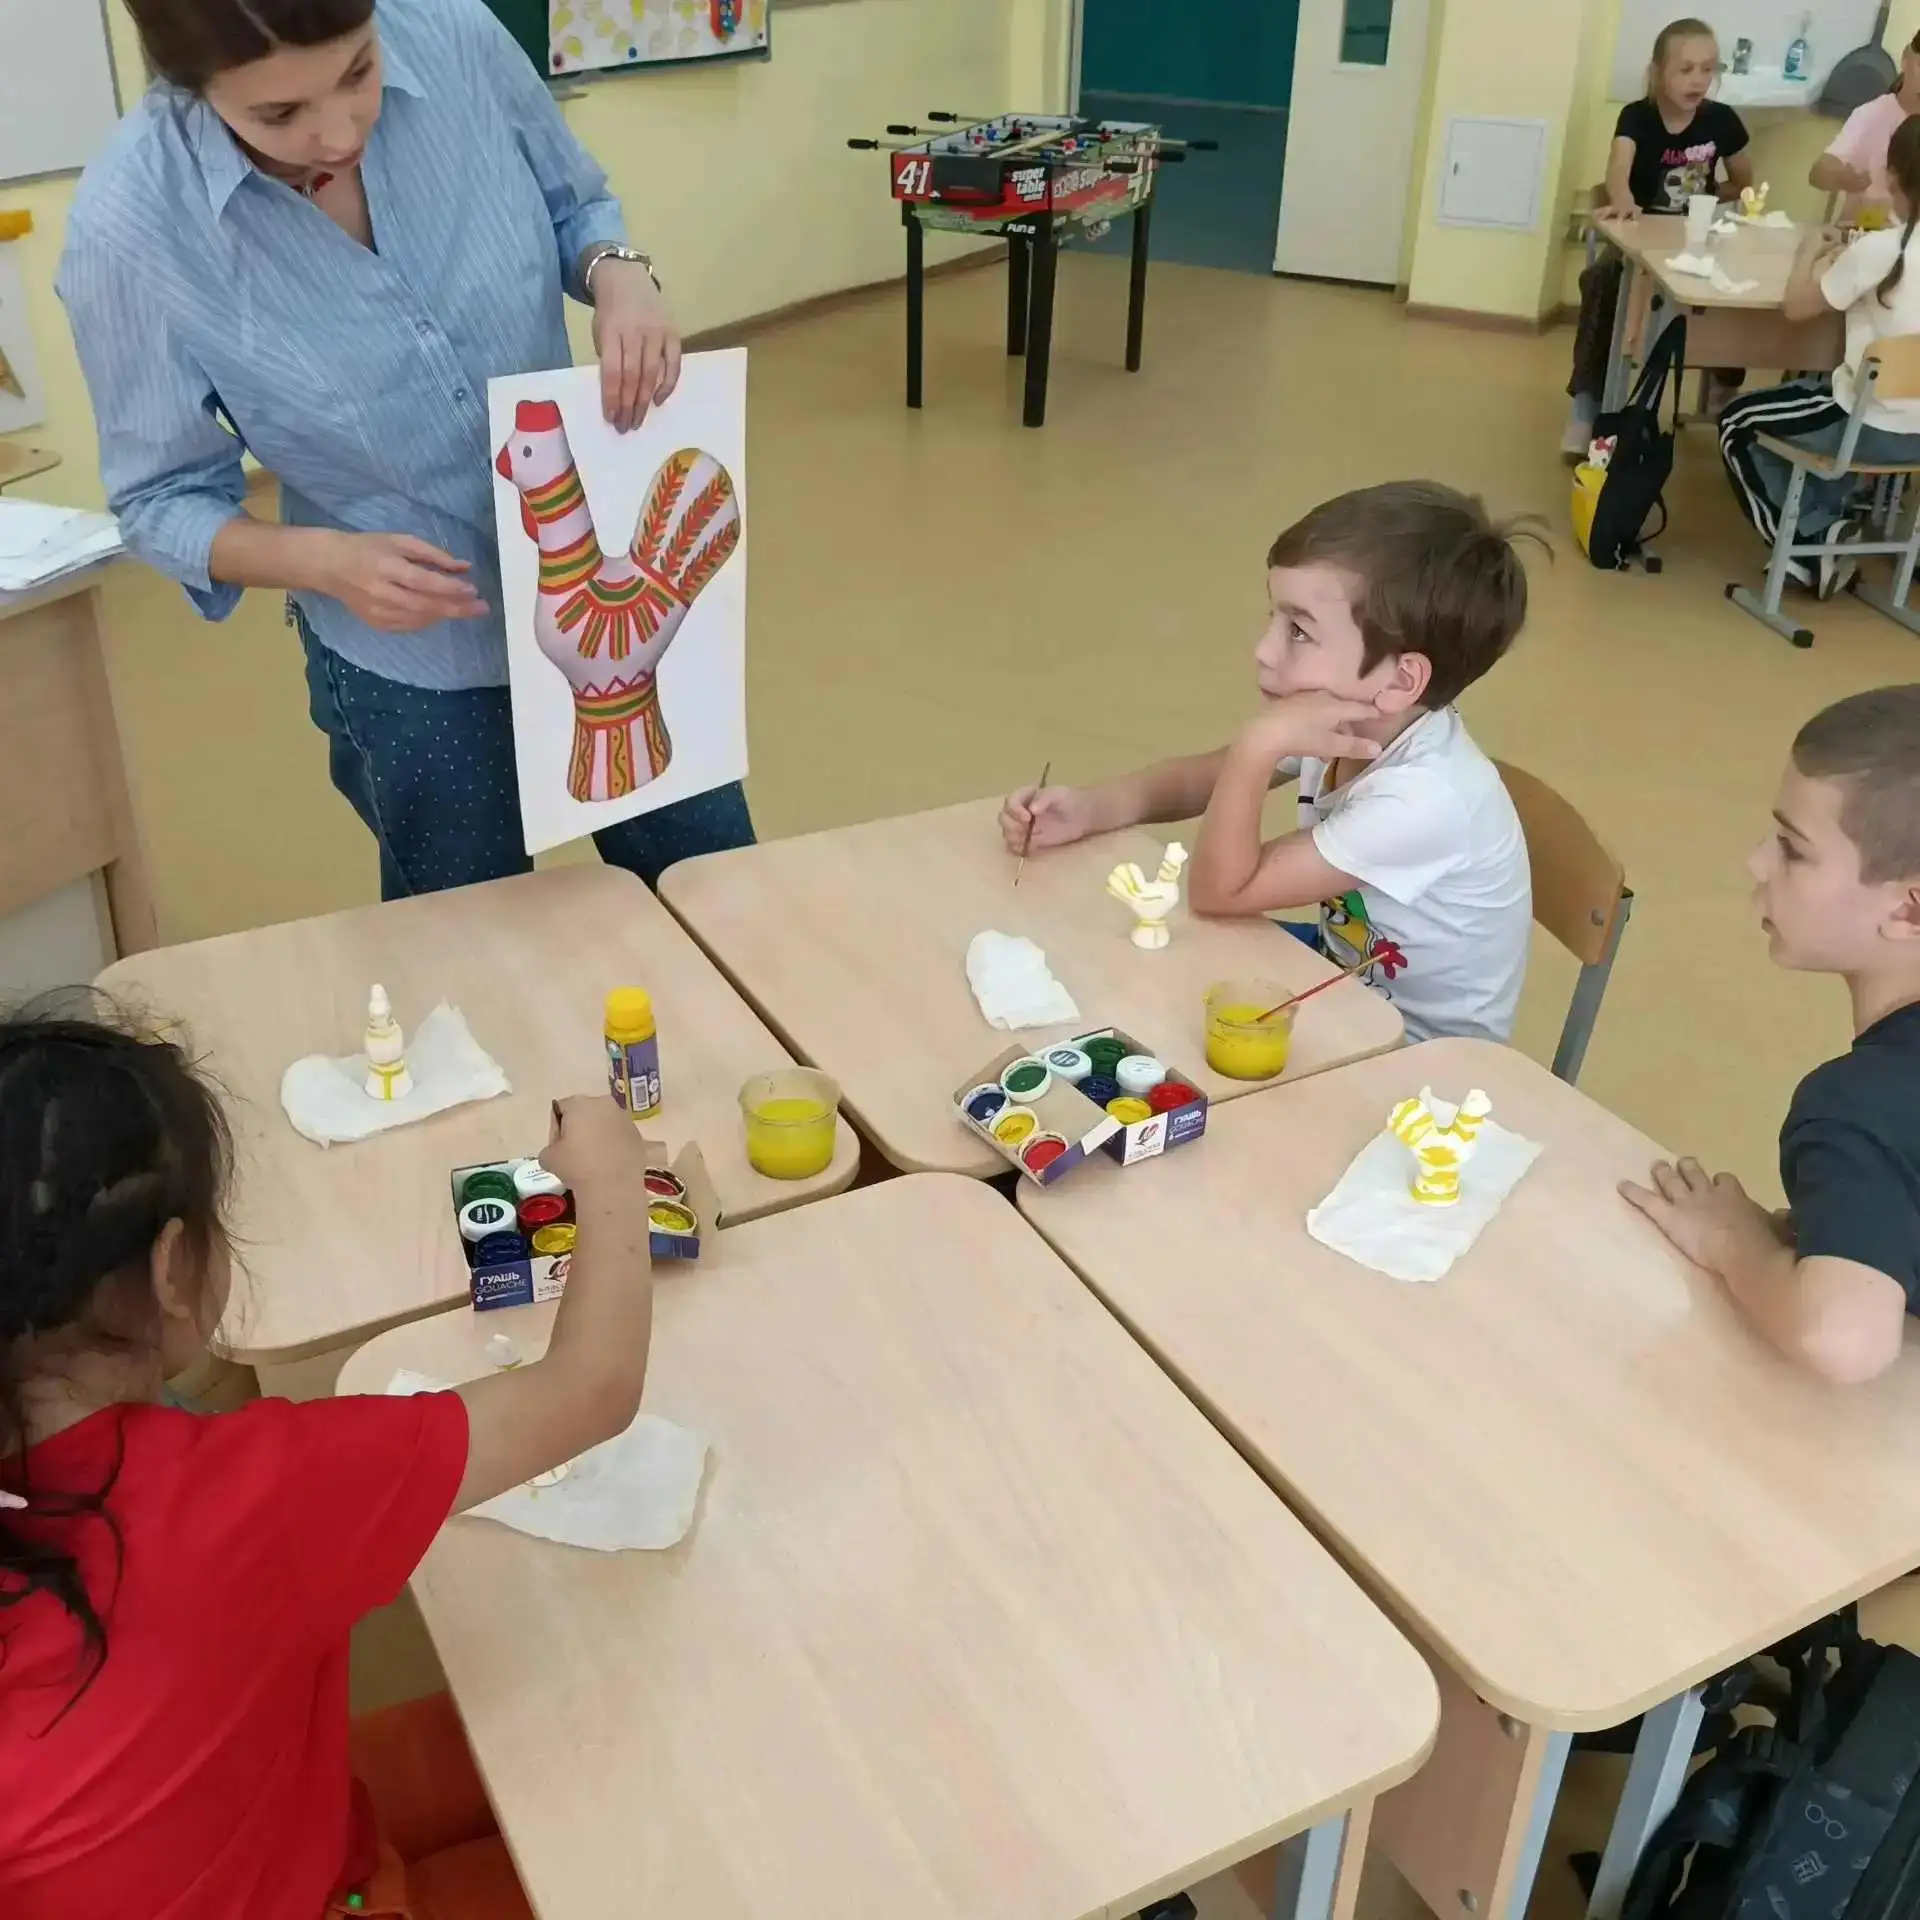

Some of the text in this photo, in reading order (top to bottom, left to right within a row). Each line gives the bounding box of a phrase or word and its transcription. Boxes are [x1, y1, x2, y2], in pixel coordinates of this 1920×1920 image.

[896, 160, 931, 195] 41
[474, 1279, 528, 1295] GOUACHE
[480, 1272, 520, 1286] ГУАШЬ
